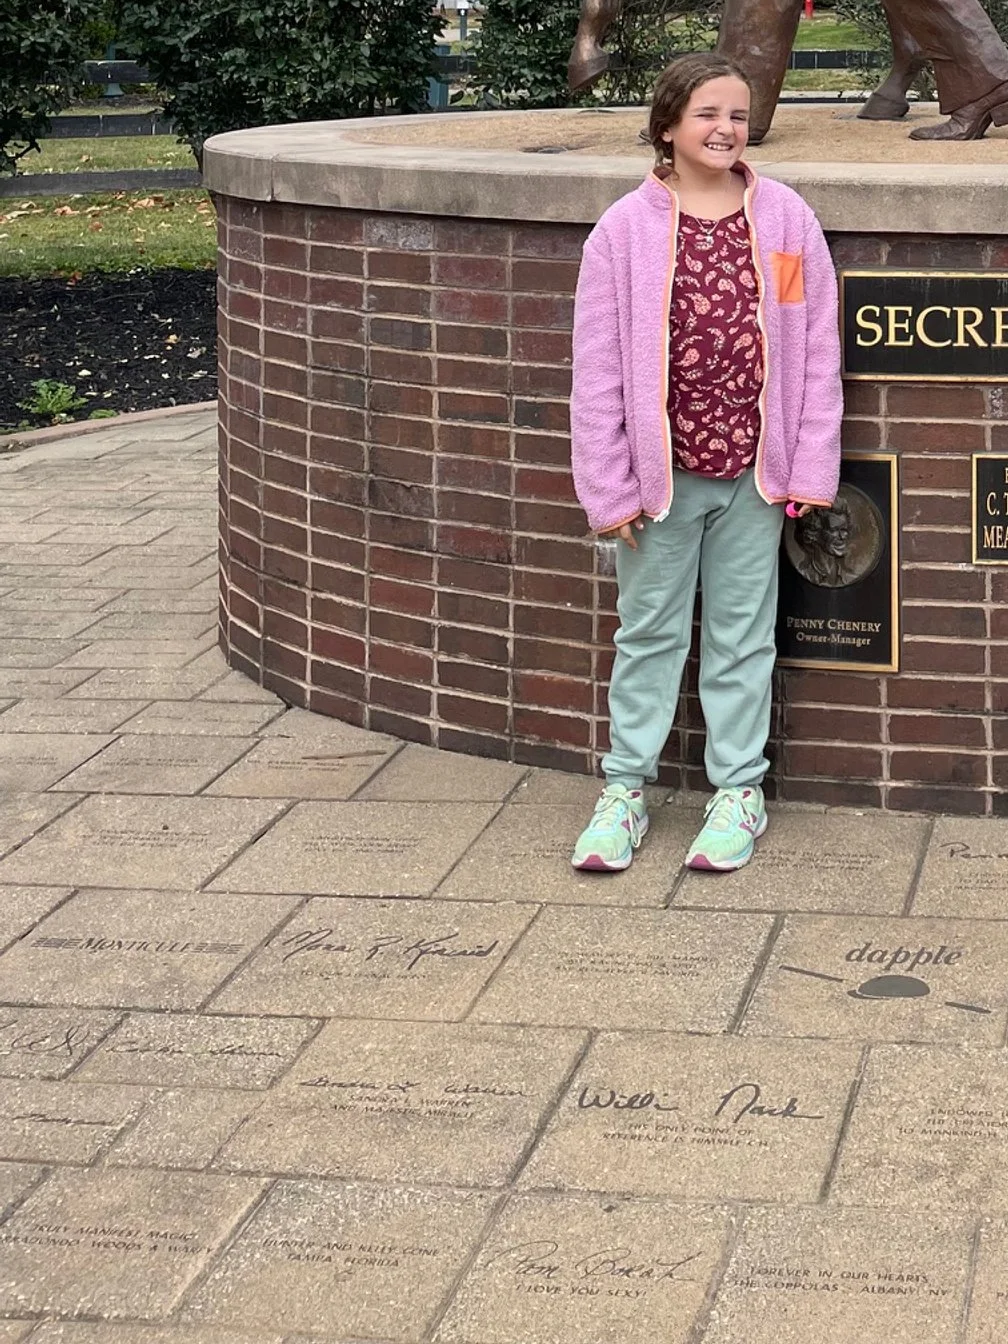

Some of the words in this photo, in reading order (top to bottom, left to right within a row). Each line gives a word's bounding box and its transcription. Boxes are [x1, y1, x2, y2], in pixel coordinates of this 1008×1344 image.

[986, 492, 1000, 516] C.
[786, 616, 825, 630] PENNY
[826, 618, 882, 633] CHENERY
[795, 631, 871, 648] Owner-Manager
[845, 942, 962, 971] dapple
[818, 1269, 833, 1278] IN
[839, 1270, 870, 1280] OUR
[527, 1284, 561, 1295] LOVE
[570, 1285, 600, 1296] YOU
